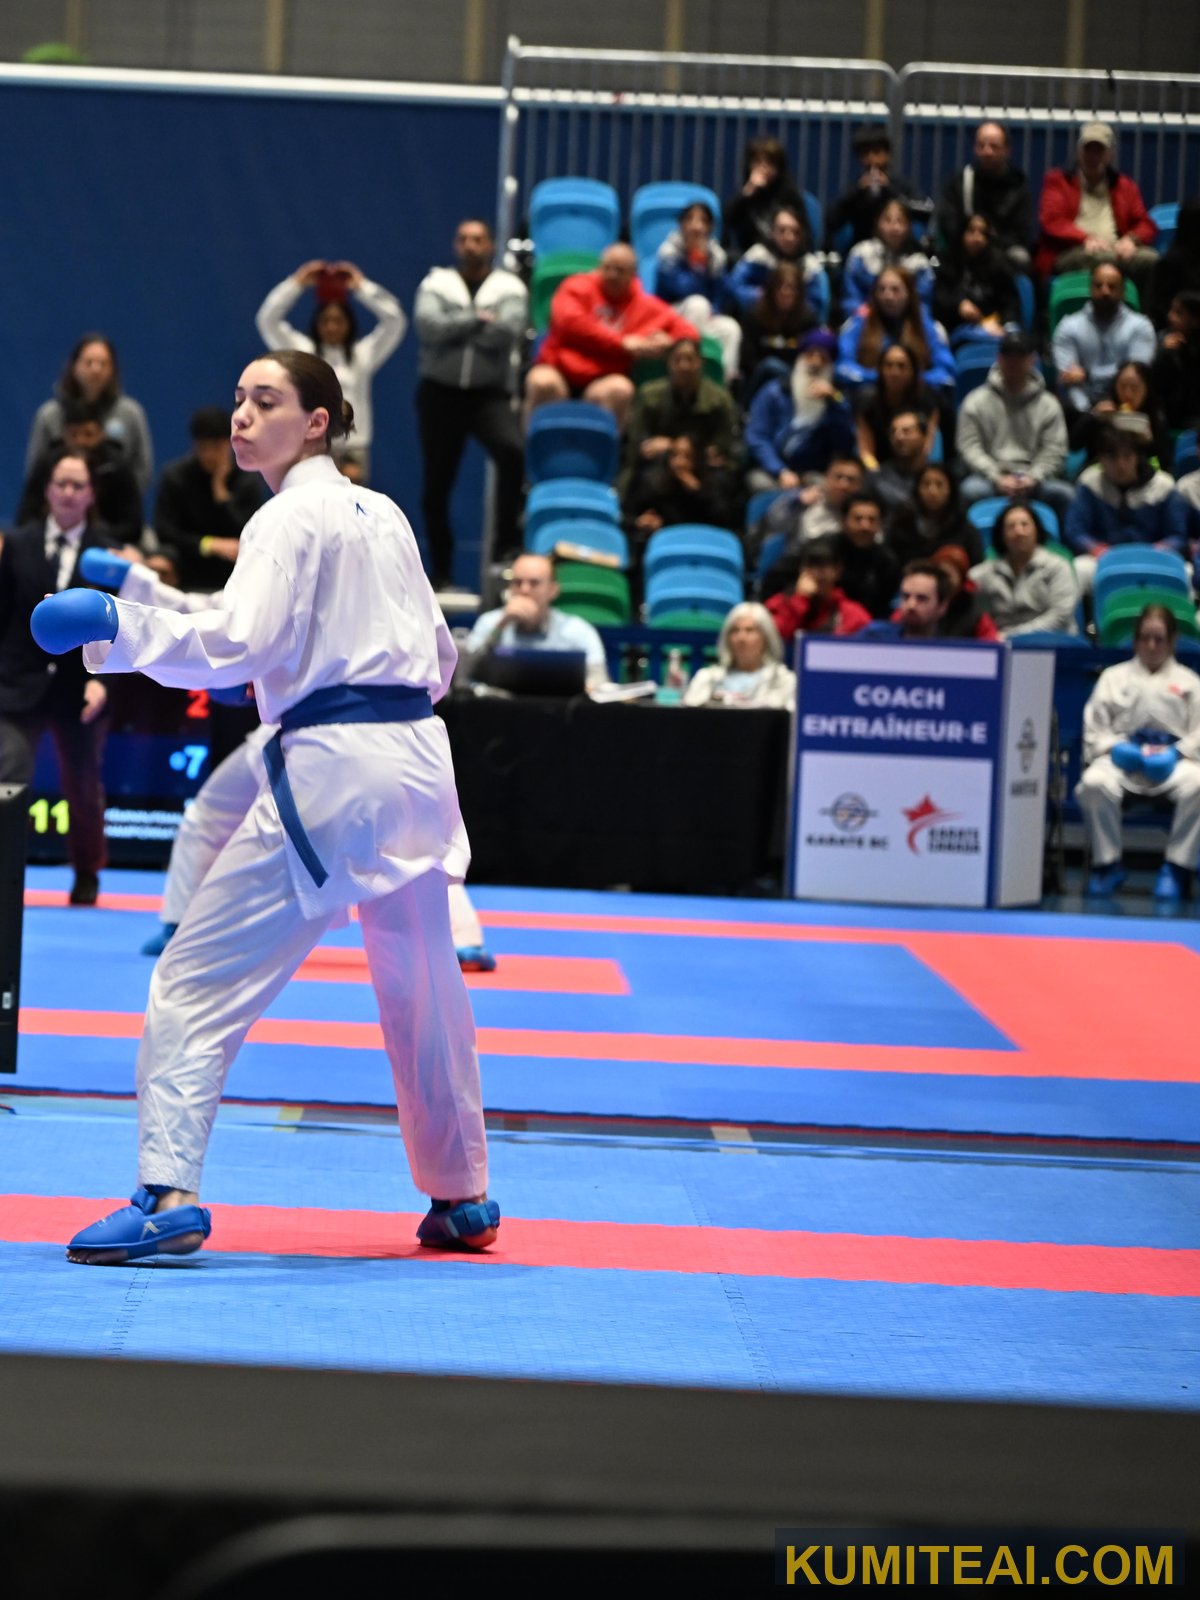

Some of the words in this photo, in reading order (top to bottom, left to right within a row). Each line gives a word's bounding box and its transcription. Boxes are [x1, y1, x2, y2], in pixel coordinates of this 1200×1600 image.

[186, 688, 210, 719] 2
[853, 684, 945, 710] COACH
[29, 799, 70, 835] 11
